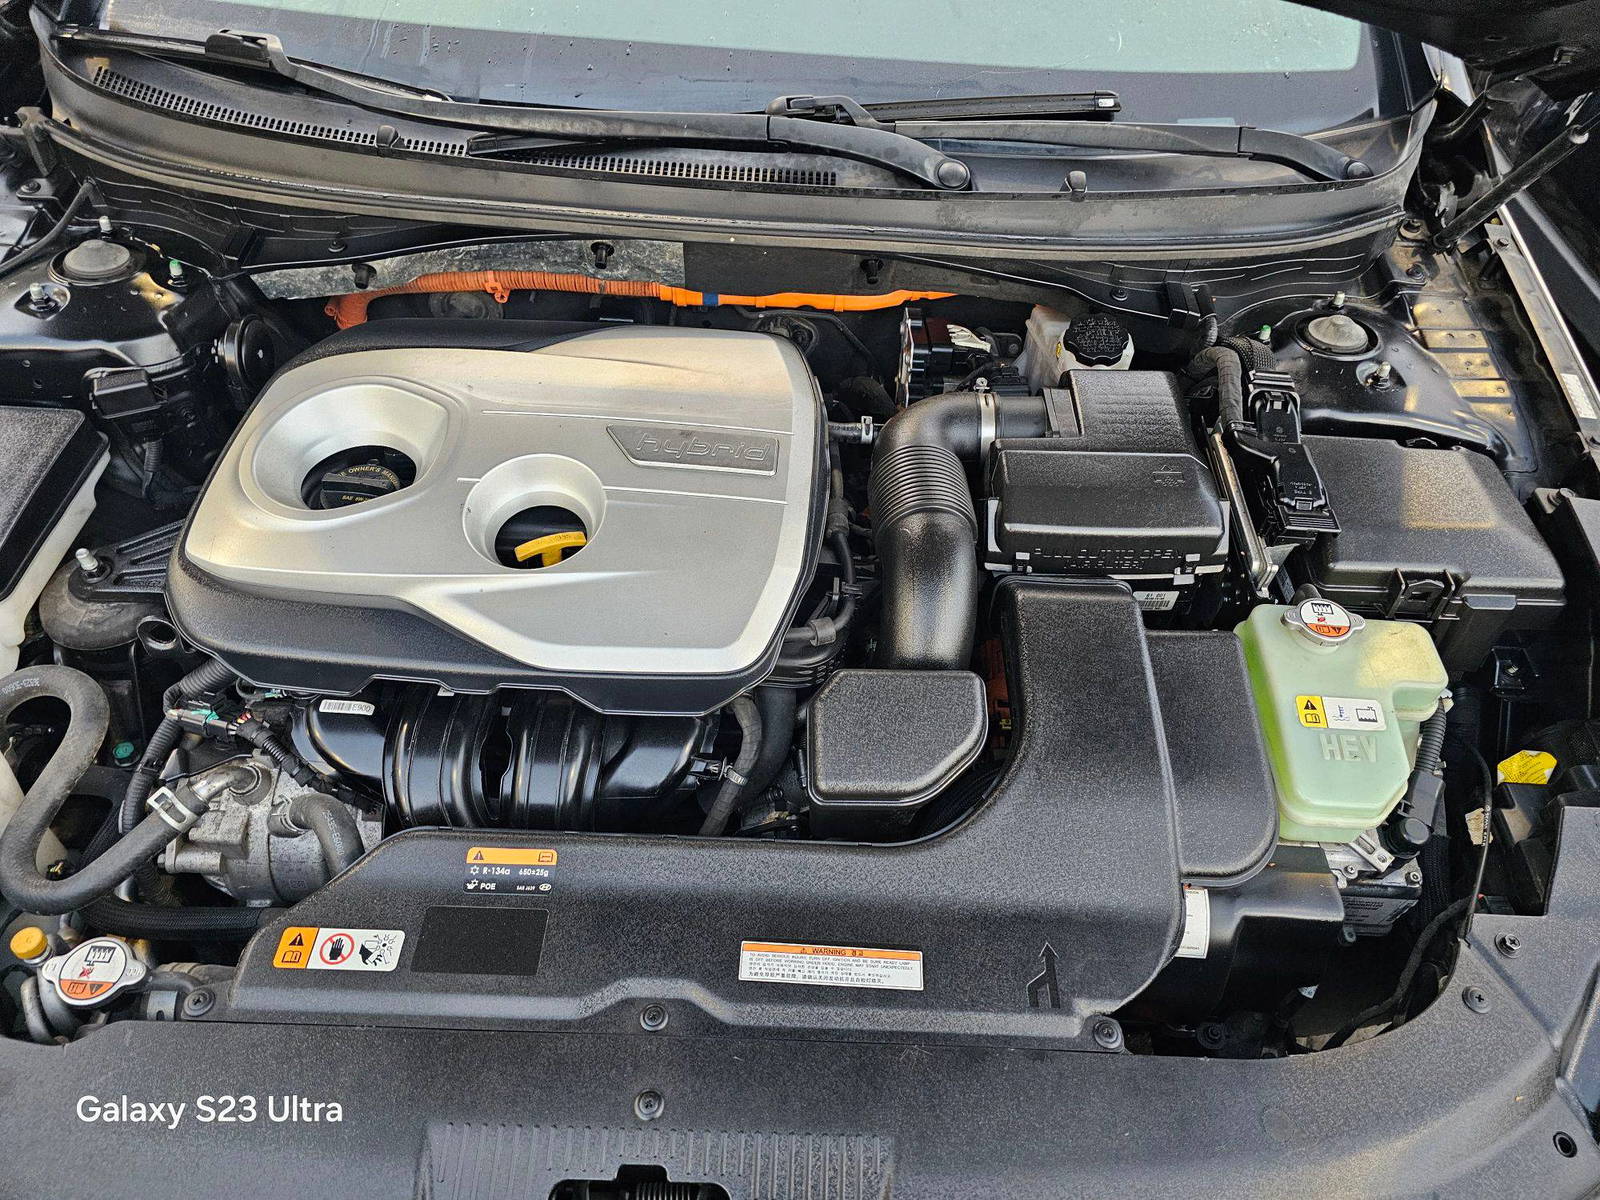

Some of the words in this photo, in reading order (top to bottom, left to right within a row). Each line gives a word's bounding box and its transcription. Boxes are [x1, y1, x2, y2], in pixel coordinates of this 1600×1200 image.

[636, 433, 771, 461] hybrid
[349, 466, 381, 474] OWNER'S
[1319, 733, 1378, 763] HEV
[482, 866, 511, 875] R-134a
[518, 867, 549, 878] 650±25g
[480, 882, 497, 890] POE
[812, 947, 847, 956] WARNING
